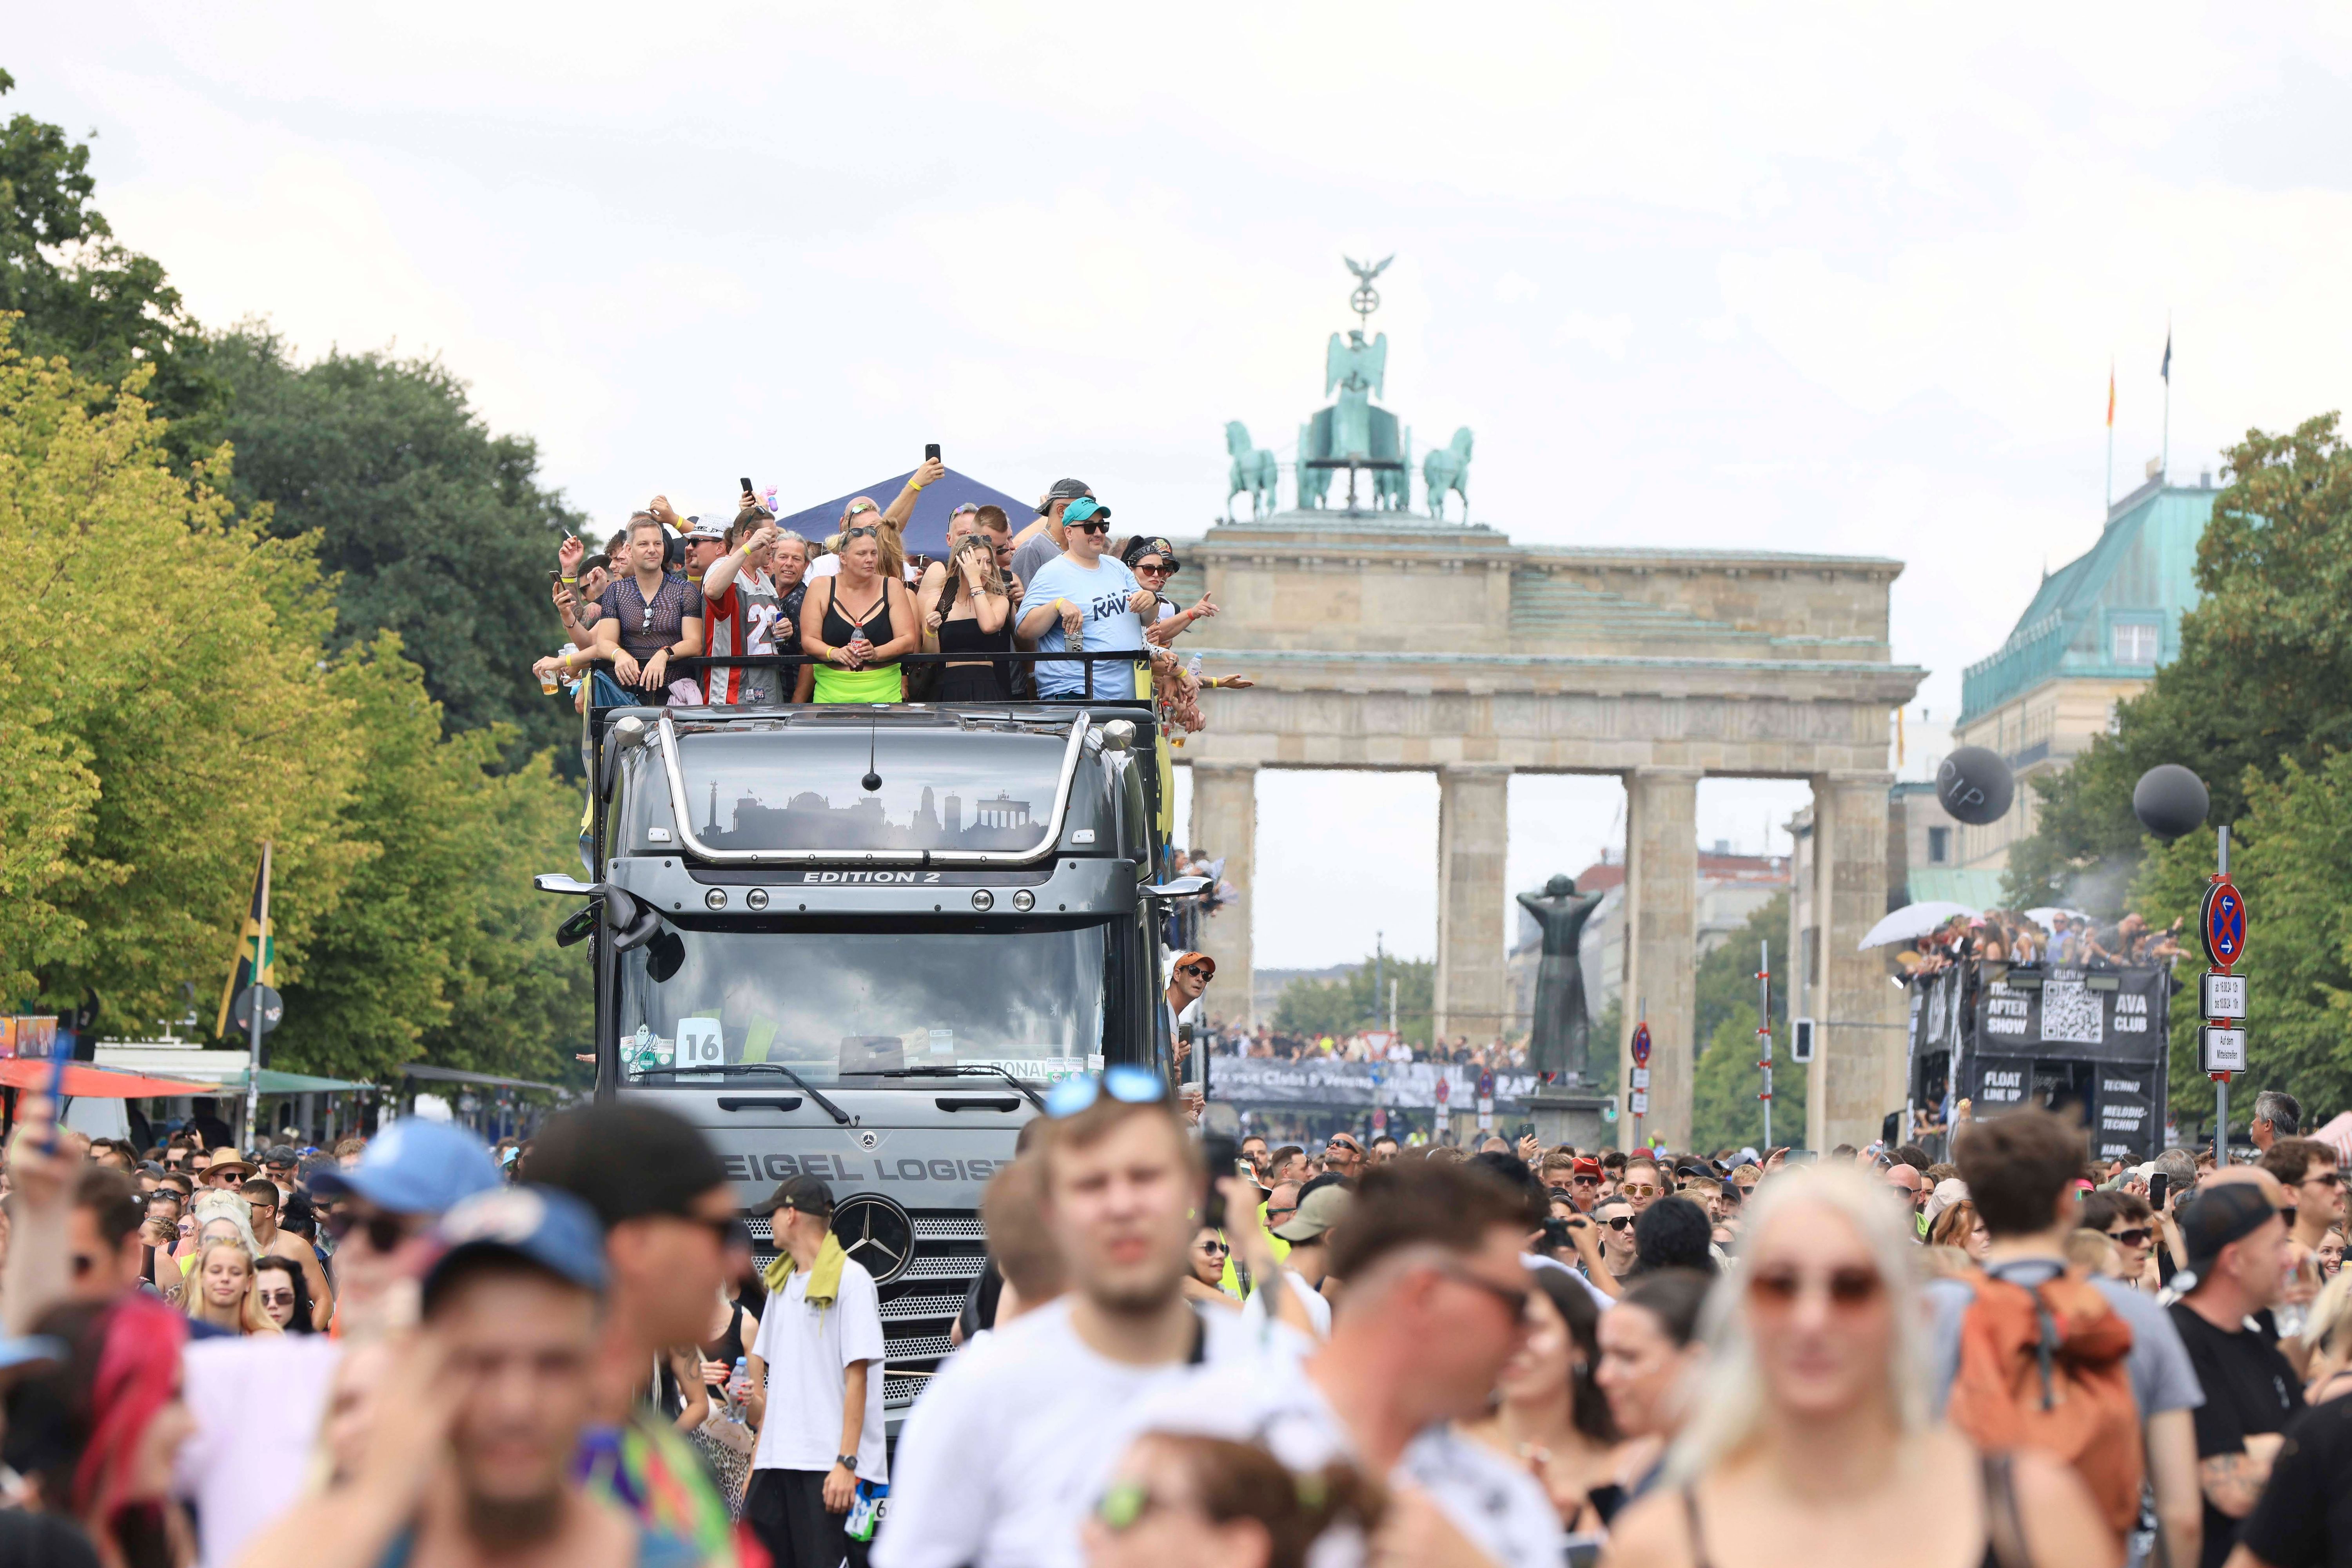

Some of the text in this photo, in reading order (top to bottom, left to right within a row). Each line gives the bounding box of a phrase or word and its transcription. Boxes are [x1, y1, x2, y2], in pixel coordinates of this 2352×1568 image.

[803, 872, 941, 882] EDITION 2
[2215, 982, 2219, 993] ab
[1987, 998, 2028, 1016] AFTER
[2115, 994, 2147, 1014] AVA
[1987, 1018, 2027, 1034] SHOW
[2114, 1016, 2147, 1032] CLUB
[686, 1034, 719, 1061] 16
[2217, 1049, 2238, 1059] Mittelstreifen
[991, 1062, 1048, 1077] RONAL
[1495, 1075, 1540, 1096] RAV
[1984, 1071, 2022, 1088] FLOAT
[2103, 1079, 2141, 1093] TECHNO
[1983, 1088, 2022, 1102] LINE UP
[2102, 1105, 2148, 1119] MELODIC-
[2102, 1118, 2140, 1132] TECHNO
[717, 1154, 864, 1181] EIGEL
